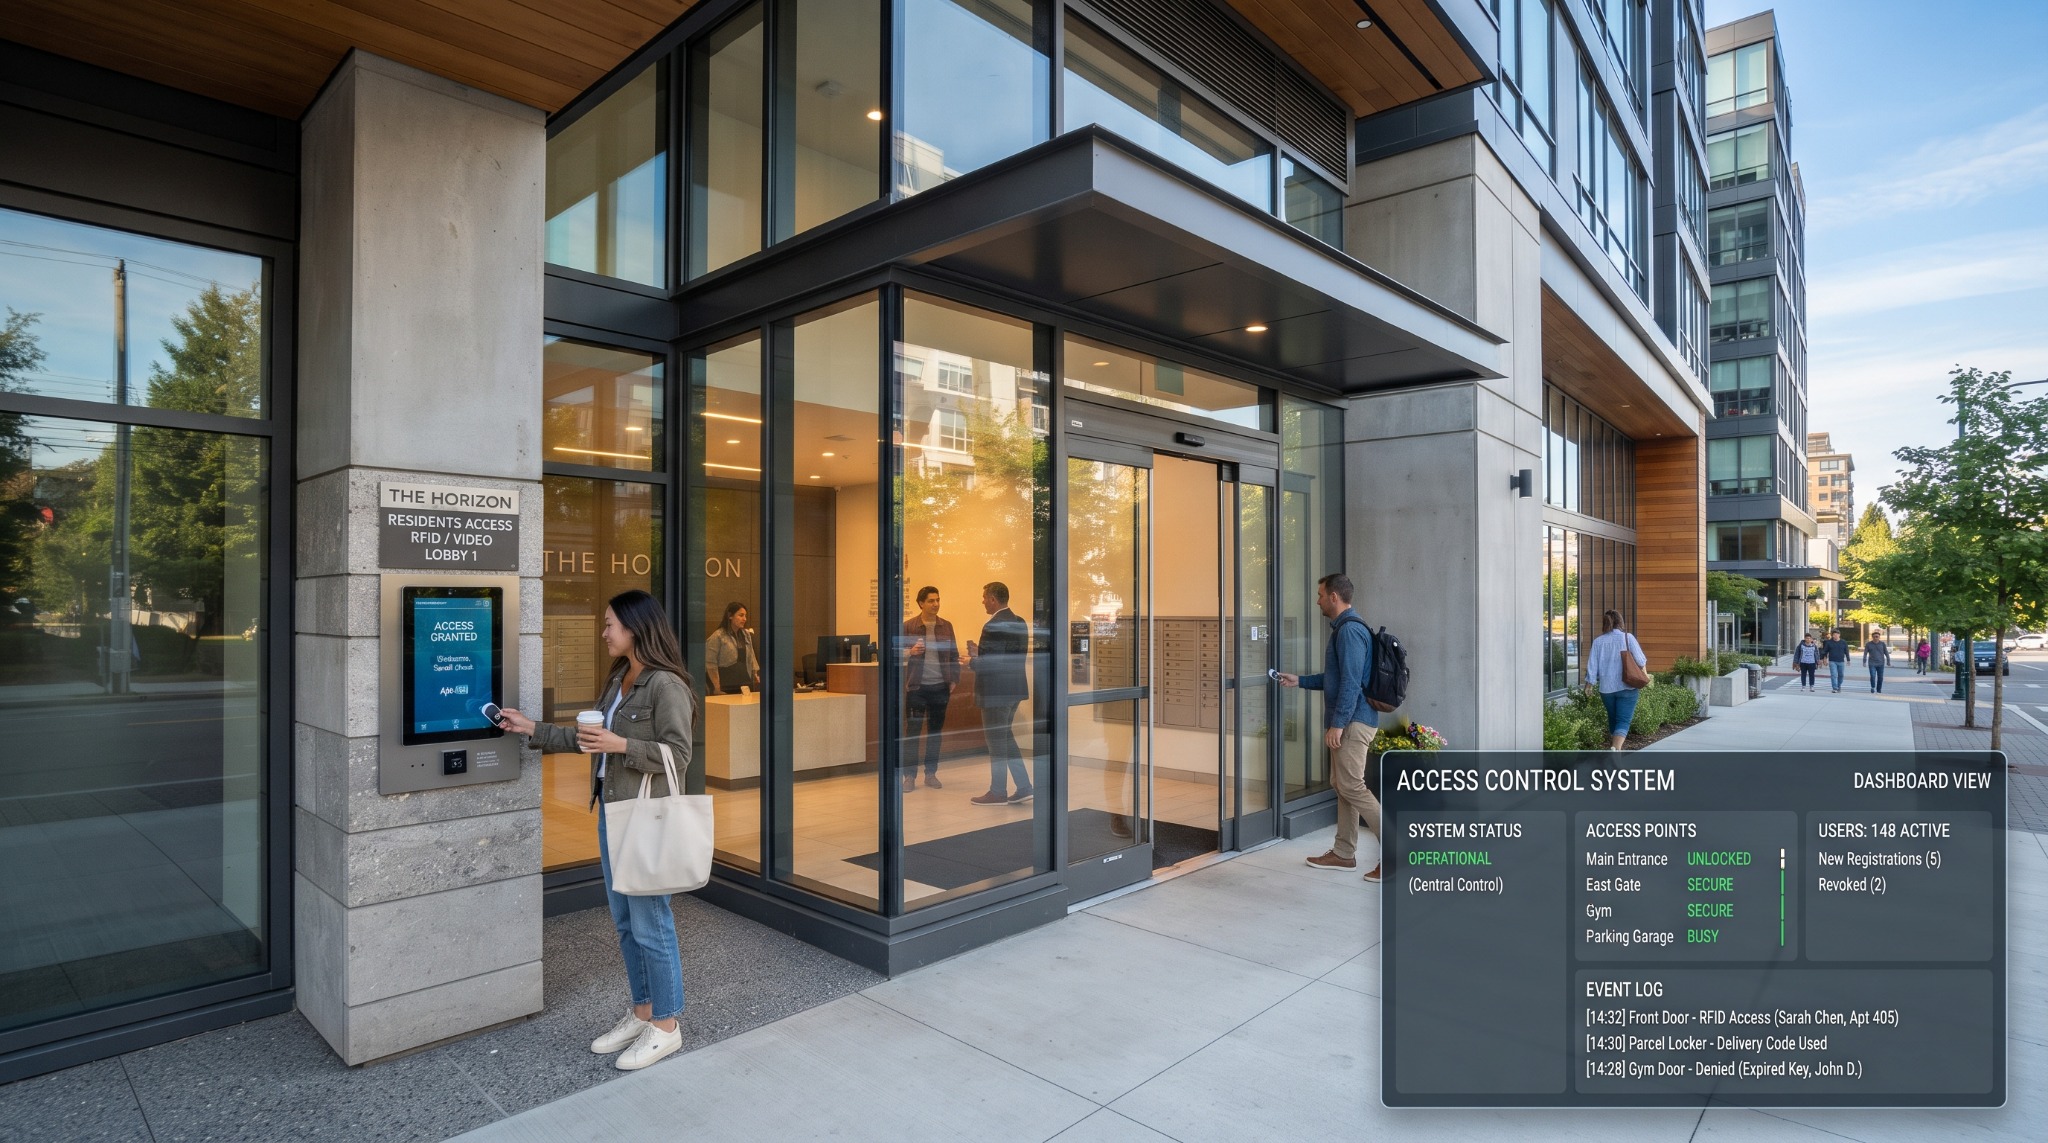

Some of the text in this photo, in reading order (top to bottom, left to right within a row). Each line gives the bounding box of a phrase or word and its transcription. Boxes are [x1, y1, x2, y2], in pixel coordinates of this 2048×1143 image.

[389, 489, 512, 509] THE HORIZON
[388, 513, 513, 531] RESIDENTS ACCESS
[411, 531, 441, 544] RFID
[453, 533, 493, 546] VIDEO
[425, 548, 477, 561] LOBBY 1
[543, 550, 595, 574] THE
[433, 621, 474, 631] ACCESS
[430, 632, 478, 642] GRANTED
